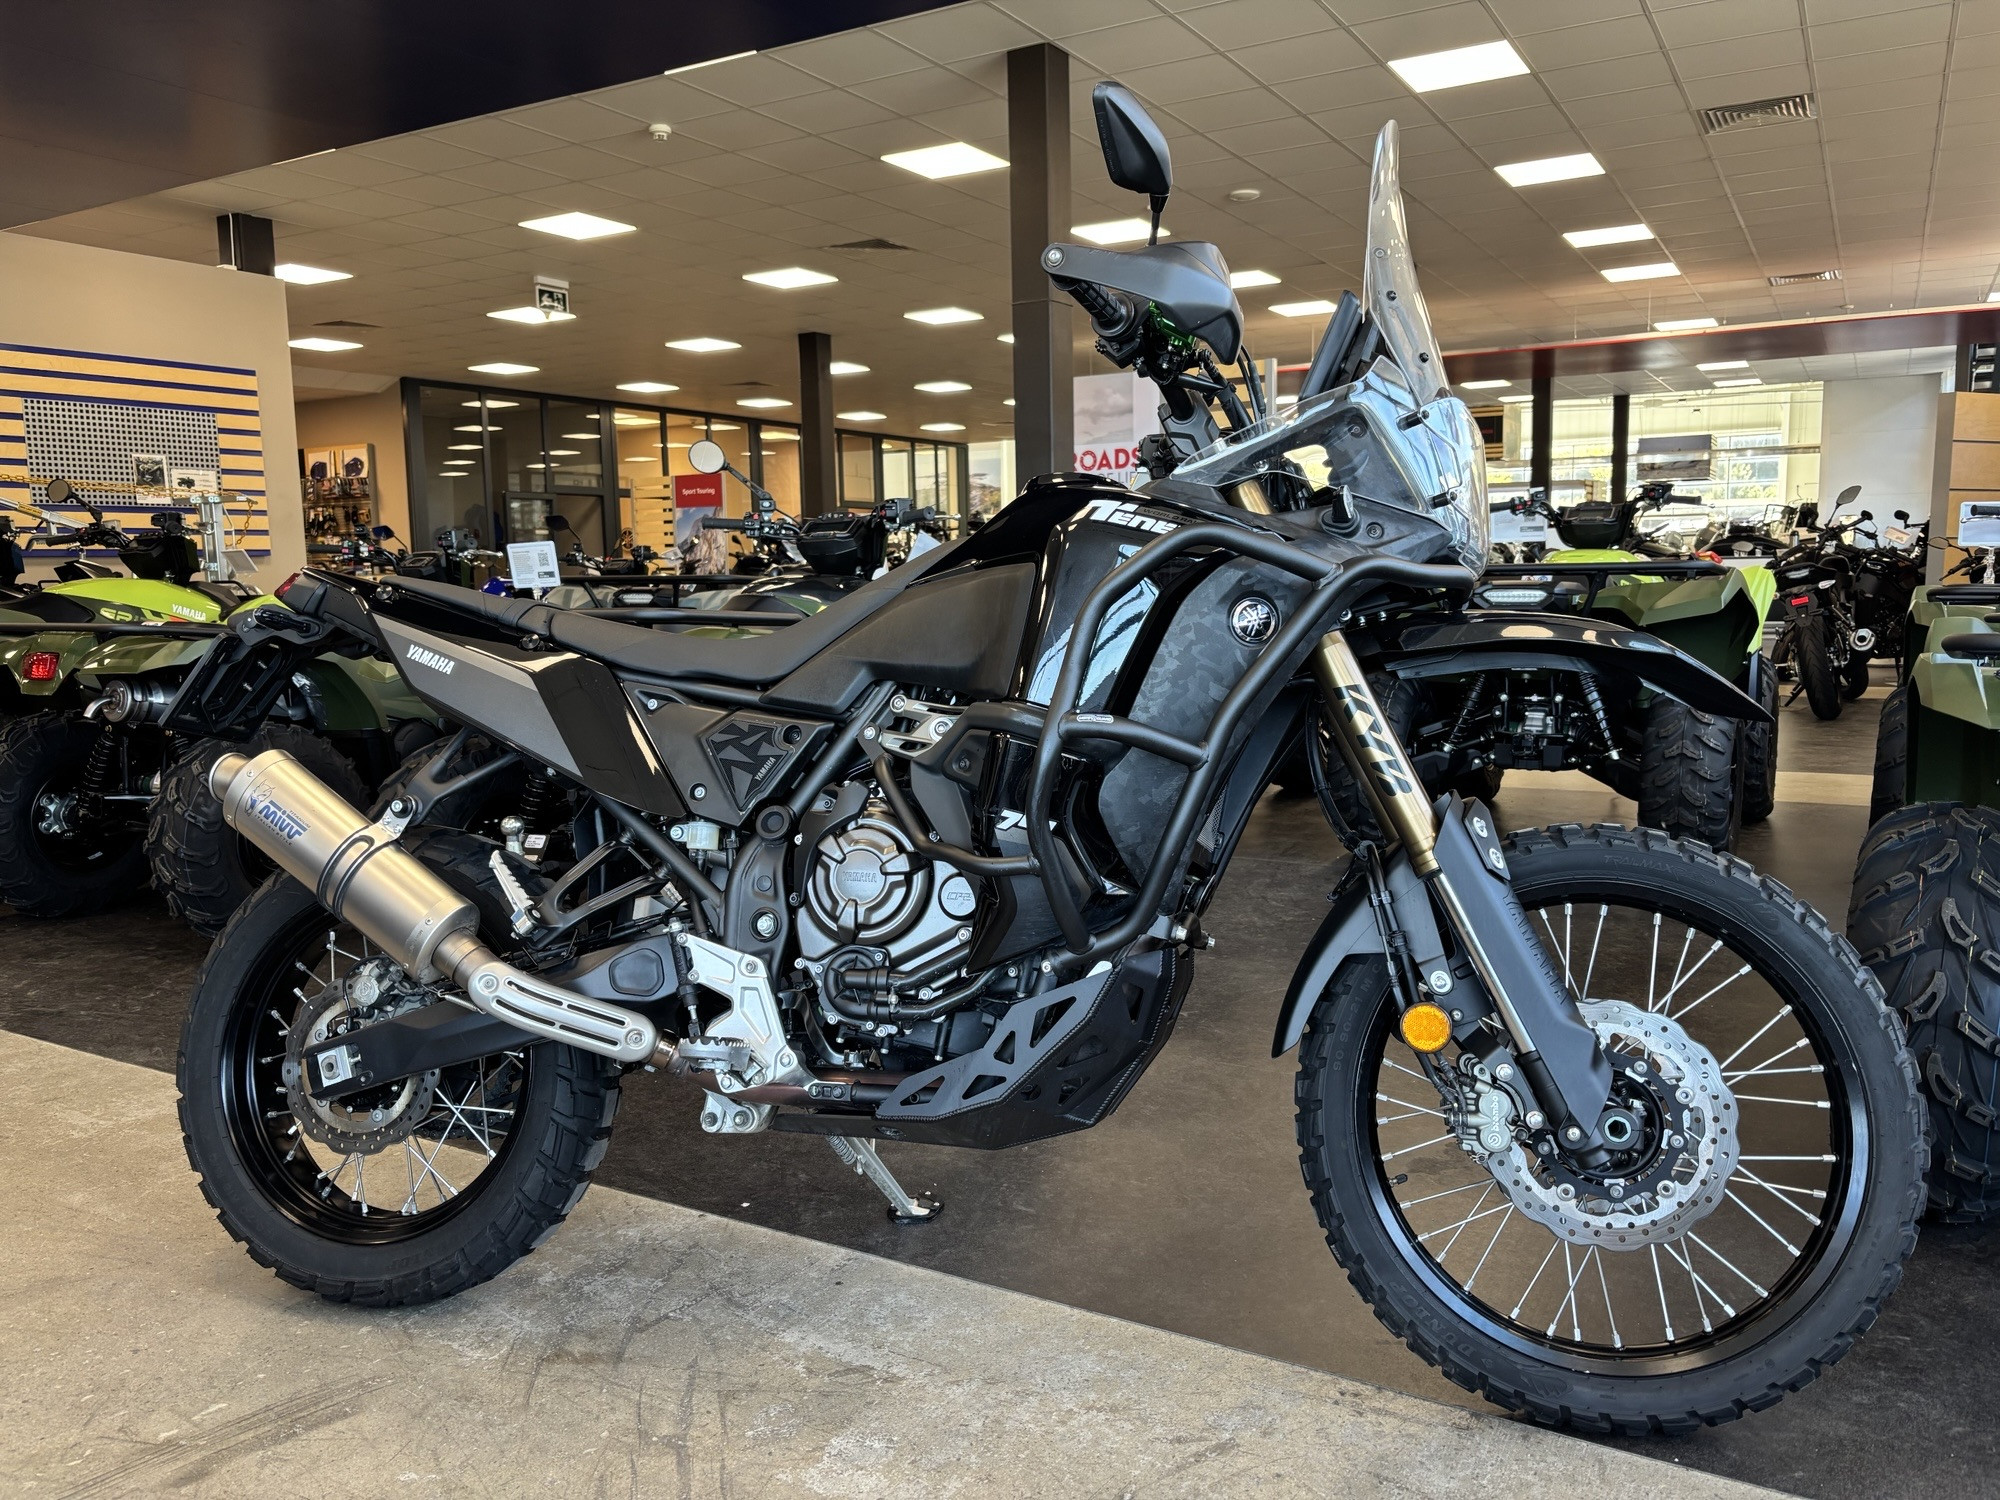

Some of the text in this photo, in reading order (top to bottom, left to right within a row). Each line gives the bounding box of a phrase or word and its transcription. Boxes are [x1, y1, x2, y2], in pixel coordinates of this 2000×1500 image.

[1073, 447, 1139, 472] OADS
[682, 487, 716, 496] Sport Touring
[1143, 508, 1180, 522] WORLD
[172, 604, 206, 621] YAMAHA
[406, 644, 455, 675] YAMAHA
[1333, 683, 1412, 797] KYB
[754, 756, 776, 781] YAMAHA
[254, 814, 292, 846] ITALIAN STYLE
[842, 870, 877, 883] YAMAHA
[1502, 887, 1570, 1006] YAMAHA
[1490, 1095, 1500, 1132] brembo
[1389, 1280, 1474, 1358] DUNLOP
